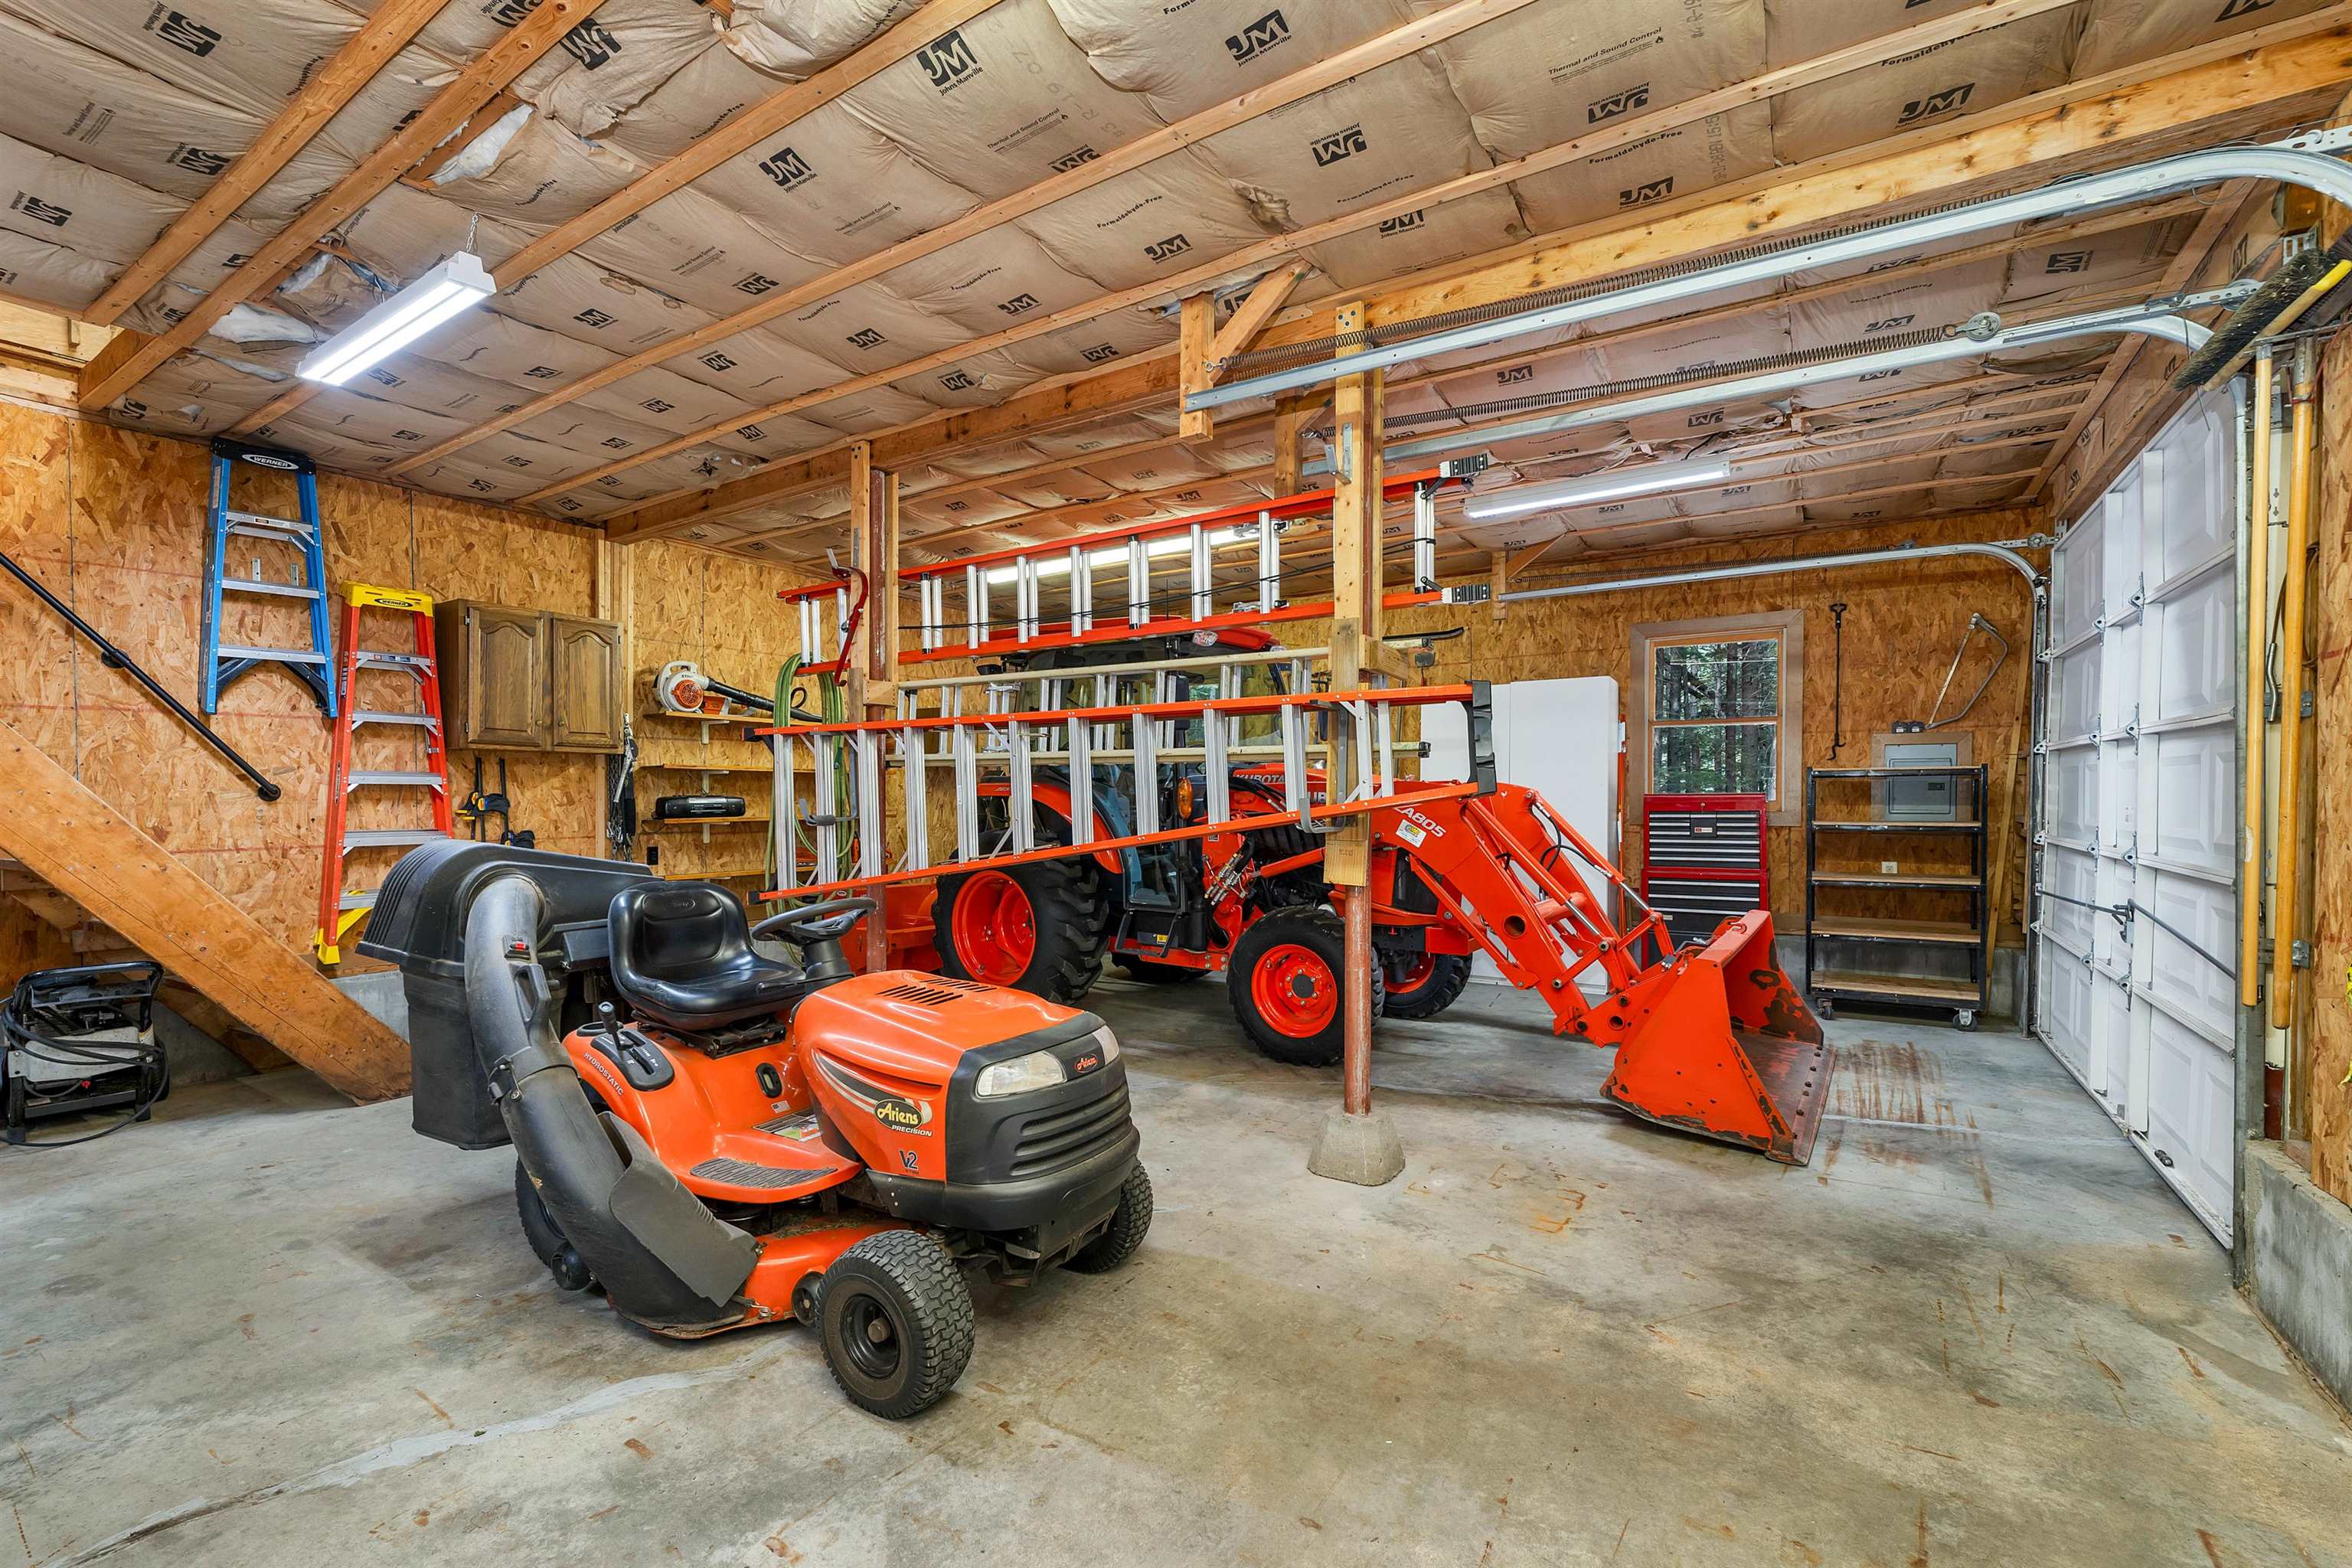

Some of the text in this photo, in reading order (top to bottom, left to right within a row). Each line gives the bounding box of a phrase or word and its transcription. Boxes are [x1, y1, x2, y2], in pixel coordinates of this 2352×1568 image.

[155, 11, 222, 57] JM
[560, 18, 622, 70] JM
[1225, 9, 1289, 60] JM
[916, 30, 978, 87] JM
[1238, 34, 1292, 68] Johns Manville
[1548, 27, 1662, 75] Thermal and Sound Control
[939, 67, 984, 96] Johns Manville
[1588, 81, 1650, 106] Johns Manville
[1589, 88, 1648, 123] JM
[1898, 83, 1975, 123] JM
[1020, 120, 1039, 132] Sound
[1038, 108, 1060, 123] Control
[1310, 122, 1361, 146] Johns Manville
[1312, 129, 1367, 167] JM
[1589, 131, 1682, 164] Formaldehyde-Free
[176, 148, 231, 175] JM
[759, 148, 812, 186] JM
[1620, 176, 1674, 205] JM
[20, 196, 73, 227] JM
[1097, 195, 1163, 228] Formaldehyde-Free
[1144, 234, 1191, 260] JM
[737, 276, 779, 295] JM
[998, 293, 1039, 314] JM
[573, 309, 614, 327] JM
[846, 328, 885, 348] JM
[701, 354, 738, 371] JM
[1082, 345, 1120, 362] JM
[940, 374, 975, 390] JM
[1497, 365, 1533, 384] JM
[1687, 410, 1724, 427] JM
[736, 425, 765, 439] JM
[253, 456, 289, 467] WERNER
[584, 1052, 624, 1096] HYDROSTATIC
[1076, 1057, 1096, 1070] Ariens
[877, 1102, 919, 1125] Ariens
[891, 1125, 933, 1137] PRECISION
[899, 1150, 919, 1170] V2
